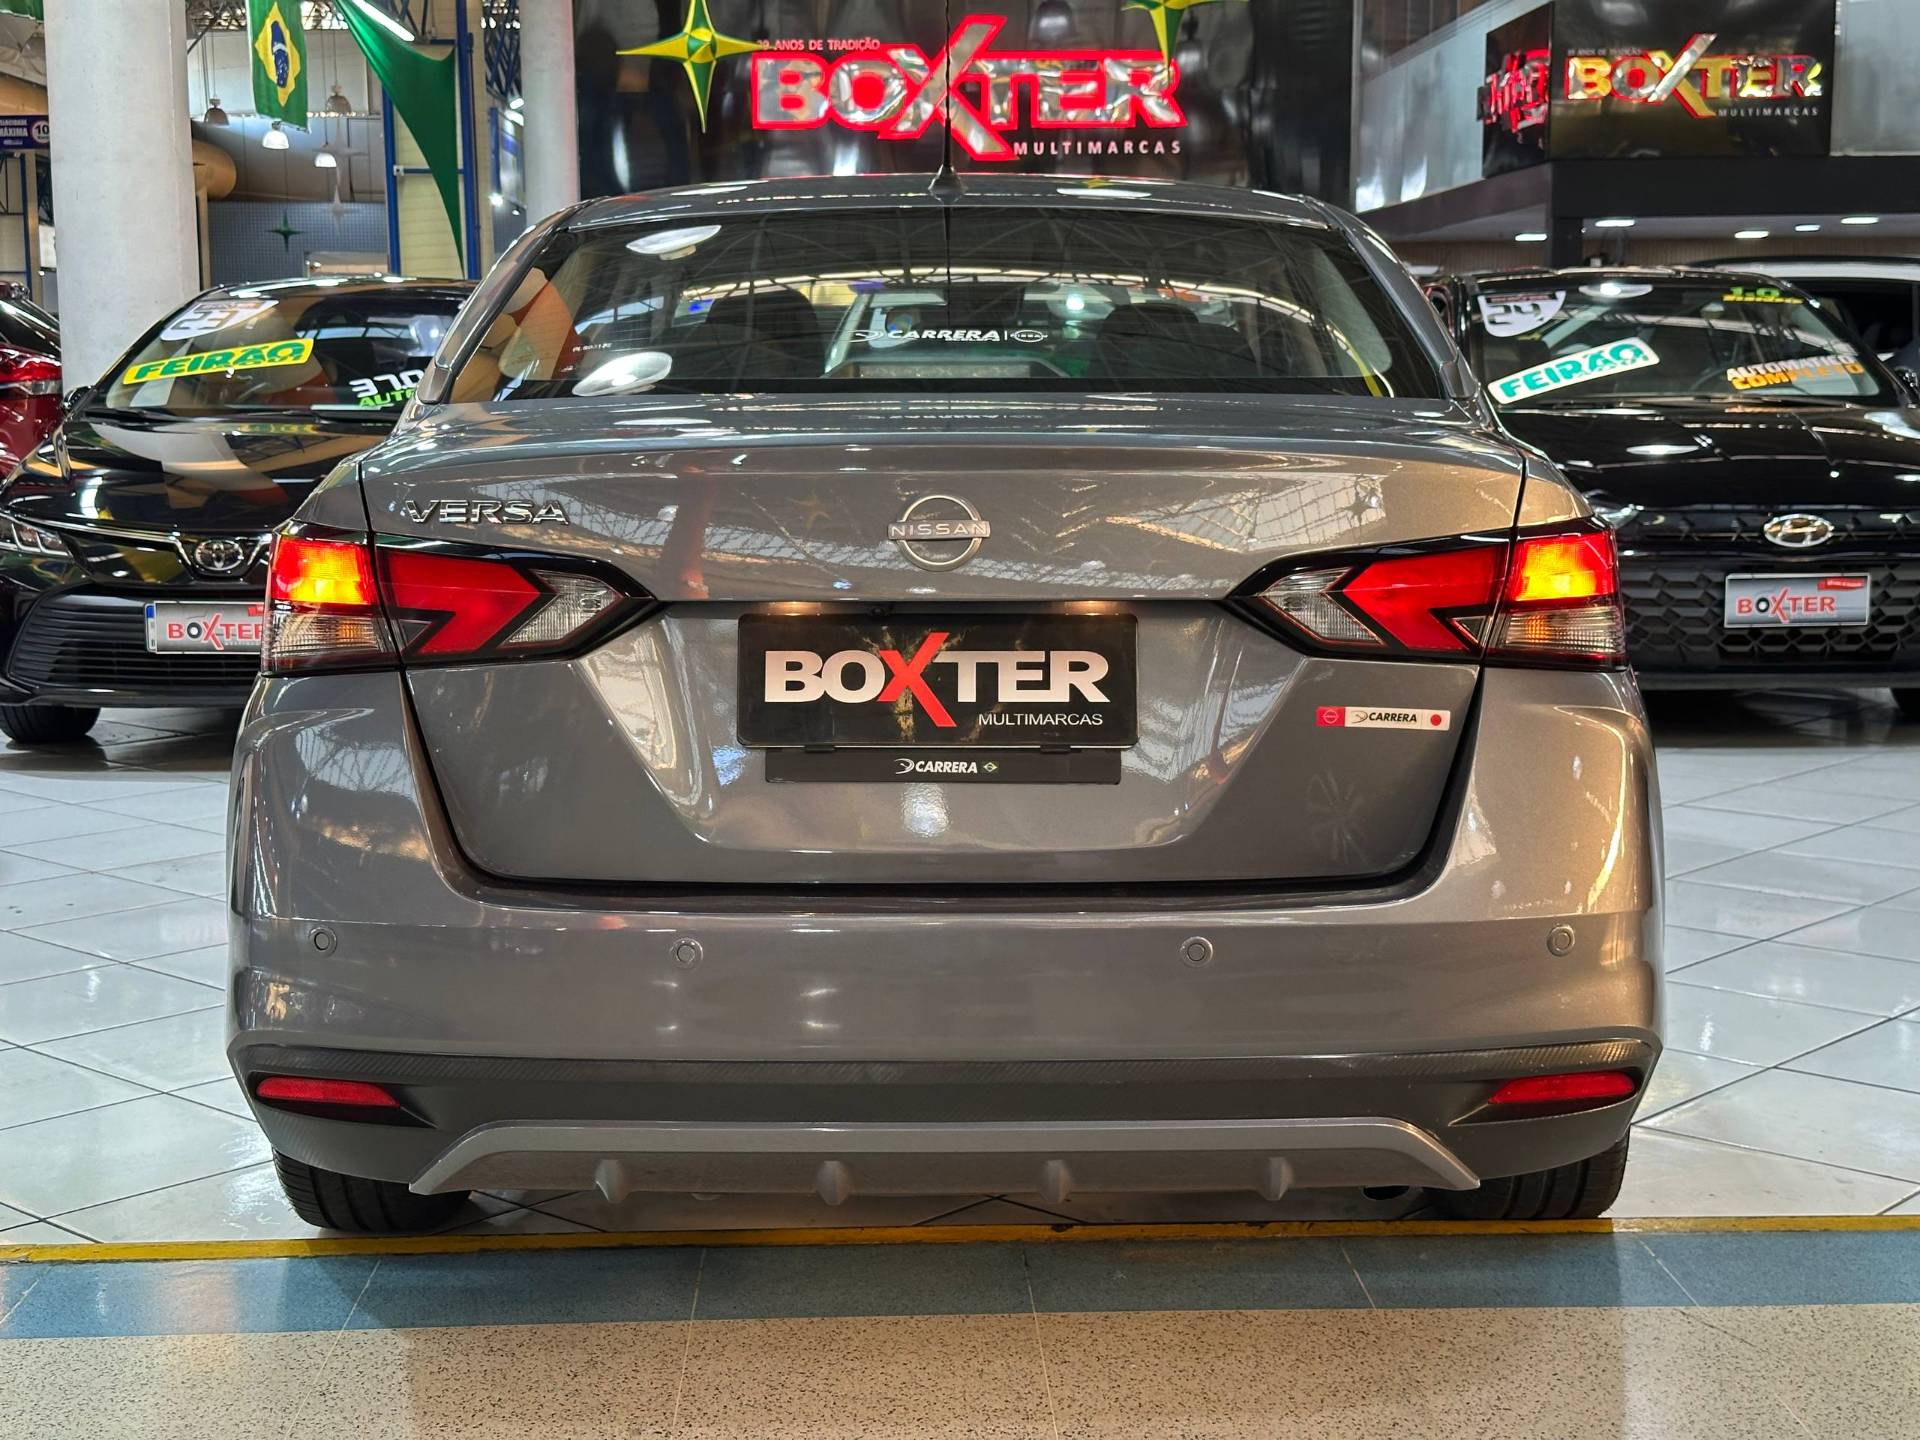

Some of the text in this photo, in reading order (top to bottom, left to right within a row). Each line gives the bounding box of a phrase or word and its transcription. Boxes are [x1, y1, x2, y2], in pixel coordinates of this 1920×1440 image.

[774, 39, 804, 51] ANOS
[808, 39, 823, 51] DE
[827, 37, 880, 52] TRADIÇÃO
[1565, 33, 1823, 118] BOXTER
[752, 15, 1187, 161] BOXTER
[1718, 106, 1819, 118] MULTIMARCAS
[34, 124, 50, 135] 10
[1013, 139, 1182, 156] MULTIMARCAS
[887, 330, 1000, 340] CARRERA
[135, 341, 305, 381] FEIRÃO
[1500, 343, 1646, 398] FEIRÃO
[405, 499, 569, 525] VERSA
[891, 522, 988, 537] NISSAN
[1736, 586, 1837, 624] BOXTER
[764, 632, 1111, 728] BOXTER
[978, 713, 1104, 726] MULTIMARCAS
[1368, 711, 1417, 723] CARRERA
[915, 760, 978, 774] CARRERA
